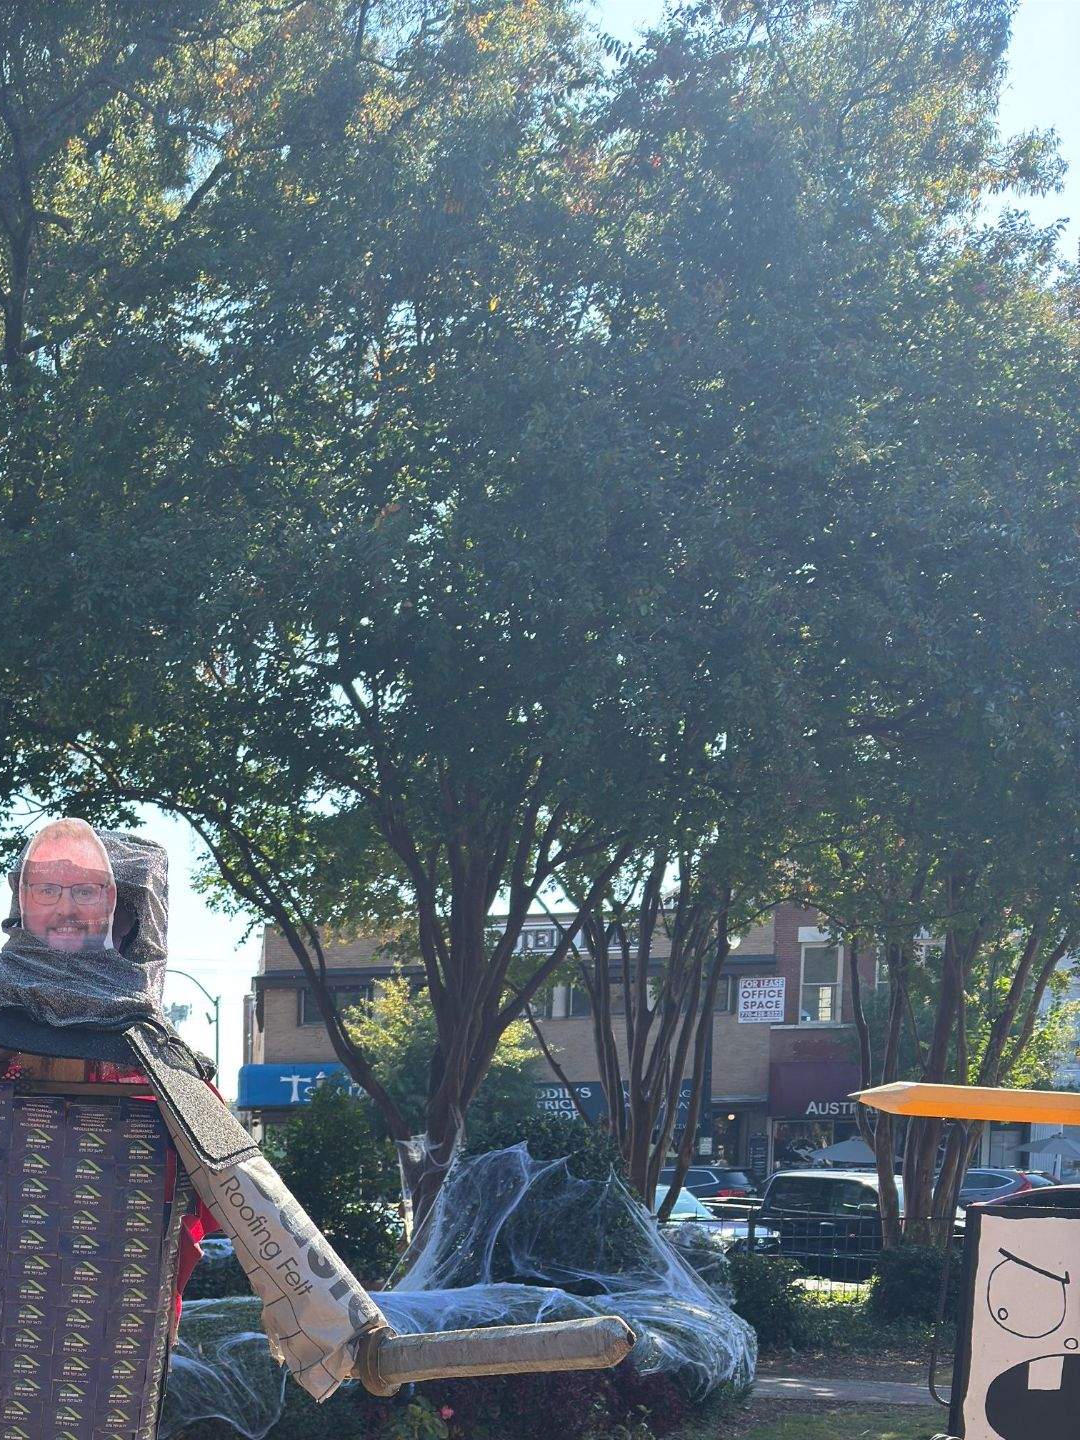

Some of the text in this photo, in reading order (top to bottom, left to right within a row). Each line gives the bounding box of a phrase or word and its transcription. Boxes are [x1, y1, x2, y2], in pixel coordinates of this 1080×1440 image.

[742, 980, 784, 988] FOR LEASE
[742, 990, 783, 998] OFFICE
[743, 1000, 780, 1009] SPACE
[220, 1176, 313, 1296] Roofing Felt
